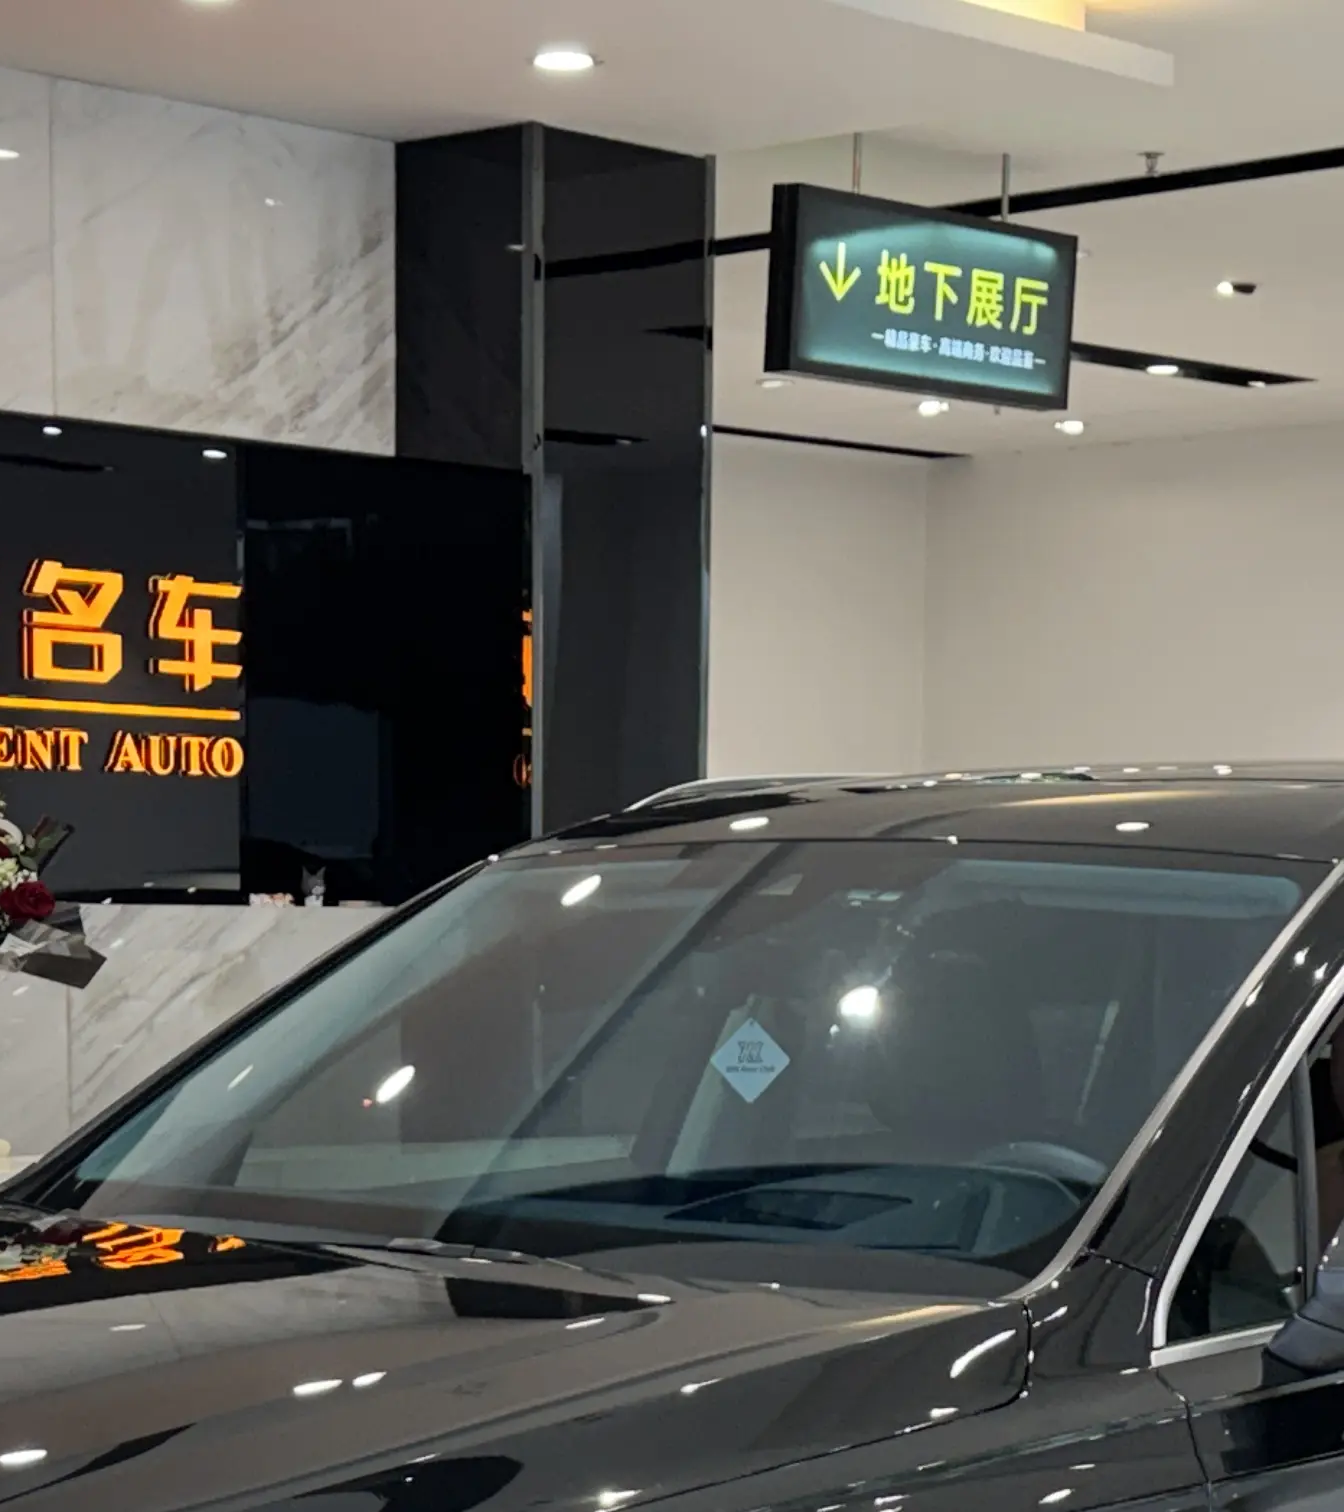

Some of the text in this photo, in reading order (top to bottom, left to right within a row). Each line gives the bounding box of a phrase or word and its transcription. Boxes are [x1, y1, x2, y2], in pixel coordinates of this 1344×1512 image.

[875, 248, 1050, 335] 地下展厅
[105, 729, 244, 778] AUTO
